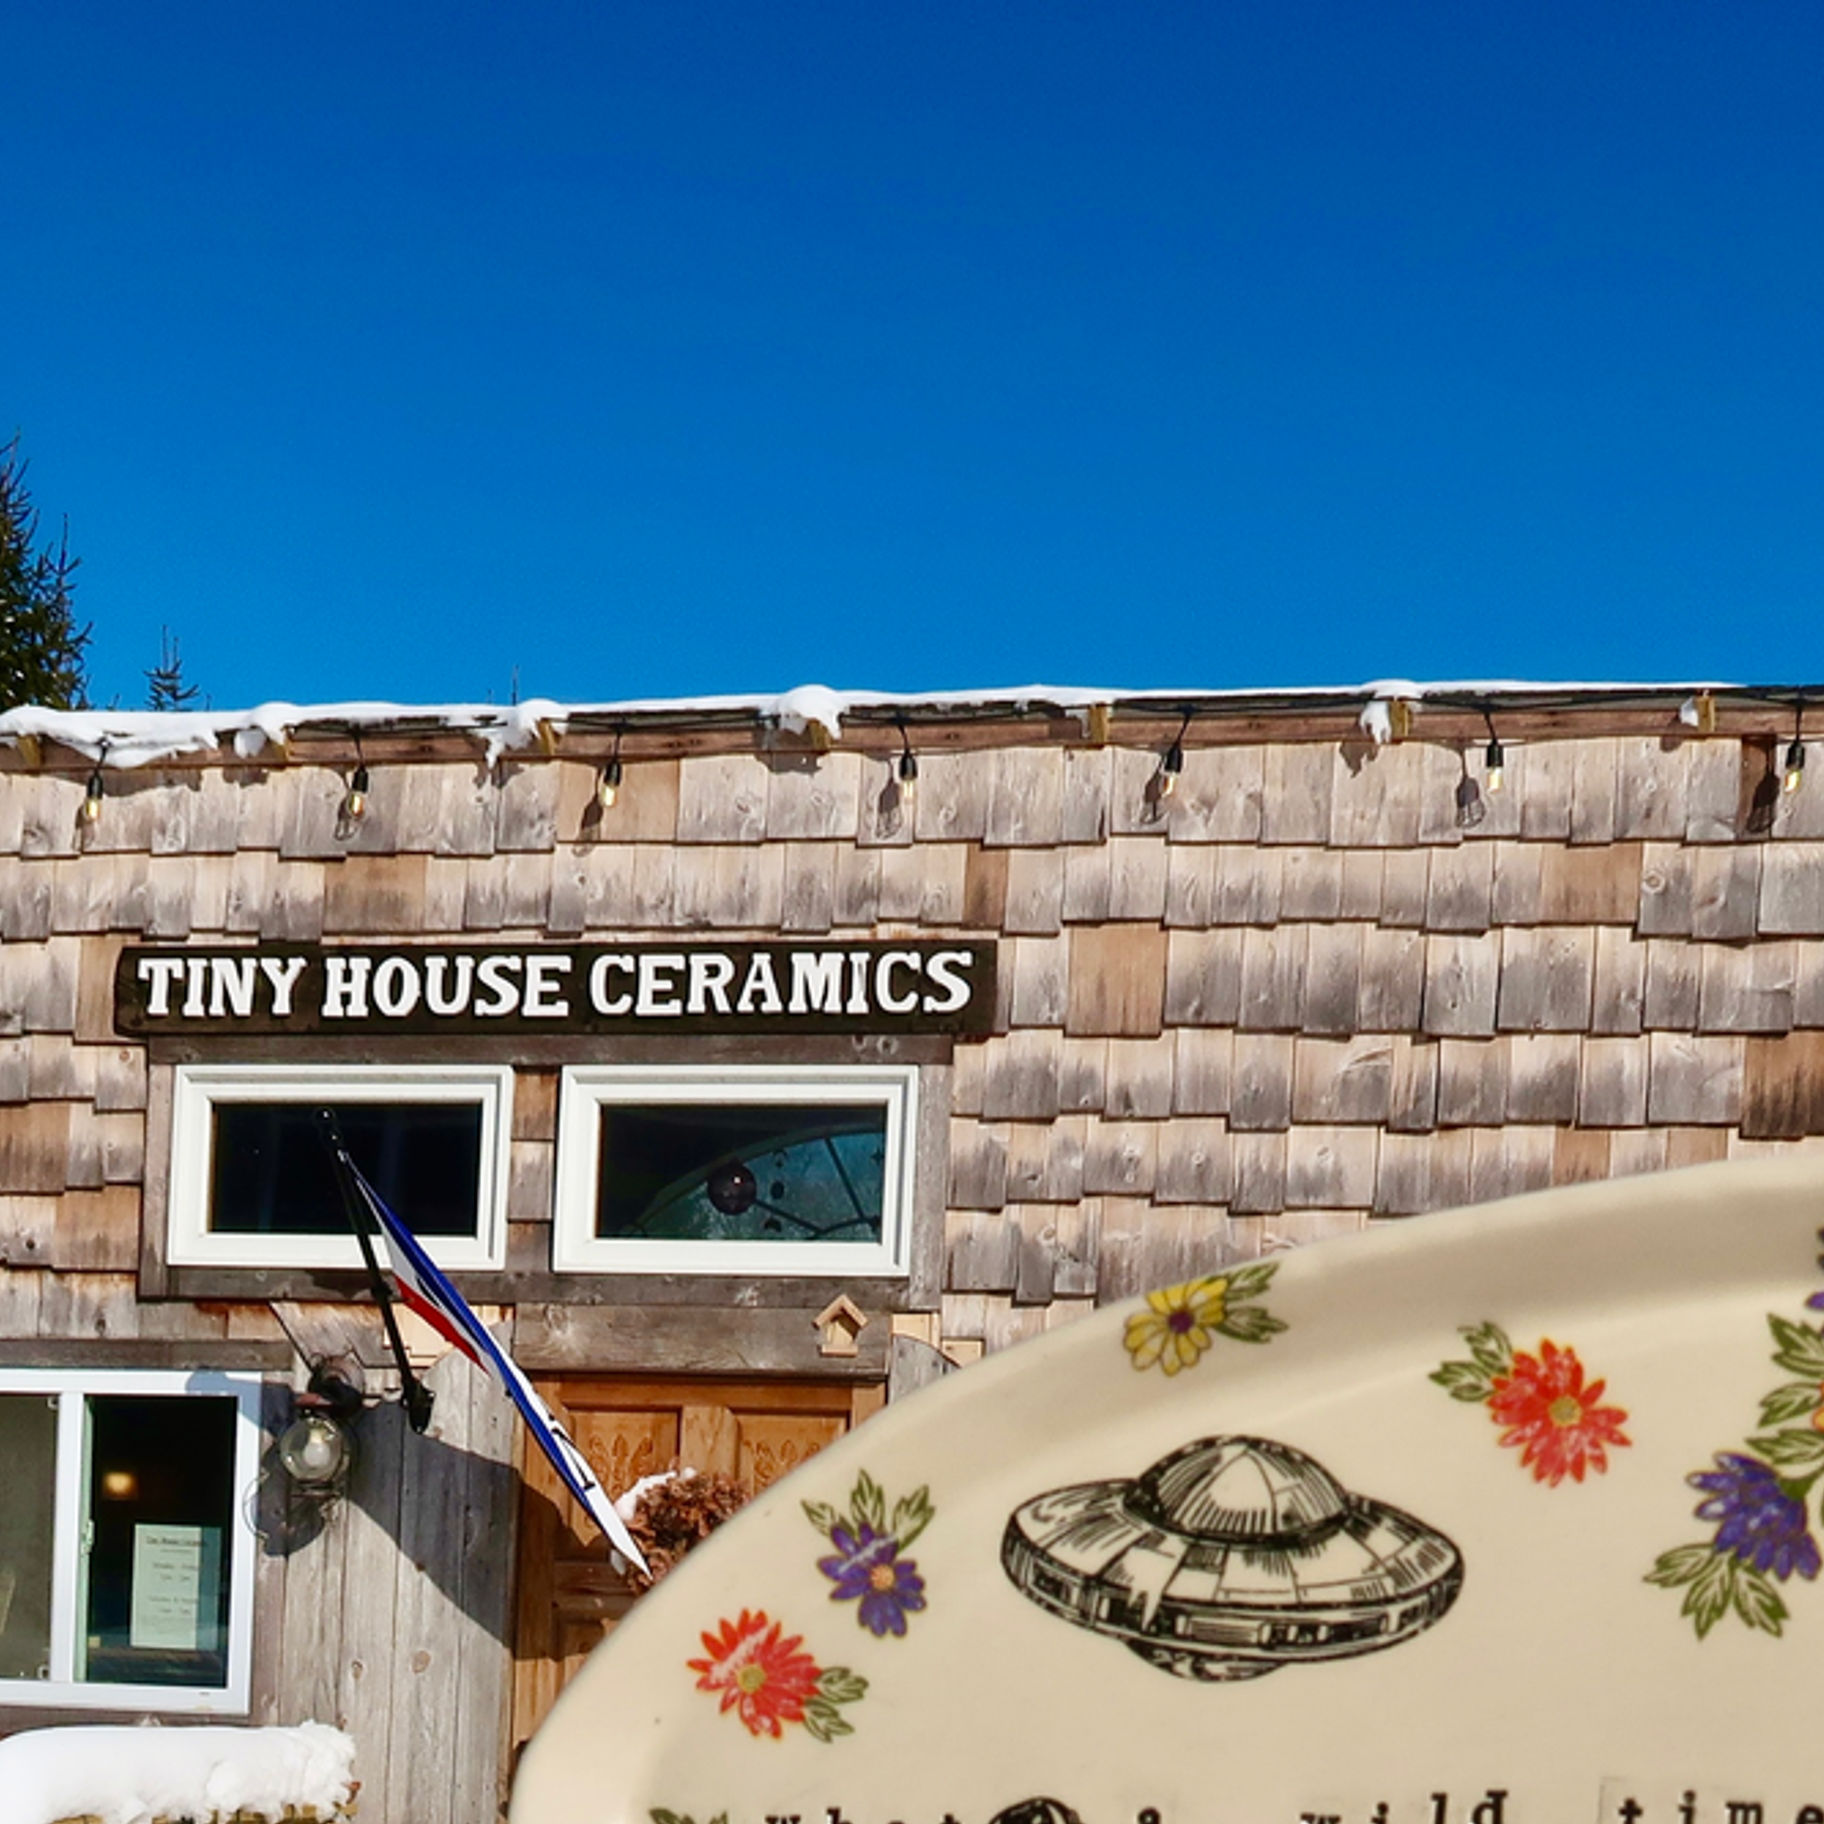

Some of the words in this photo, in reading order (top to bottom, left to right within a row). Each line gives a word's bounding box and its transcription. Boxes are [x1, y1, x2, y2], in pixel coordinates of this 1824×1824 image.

[138, 957, 307, 1017] TINY
[321, 955, 571, 1017] HOUSE
[589, 951, 973, 1016] CERAMICS
